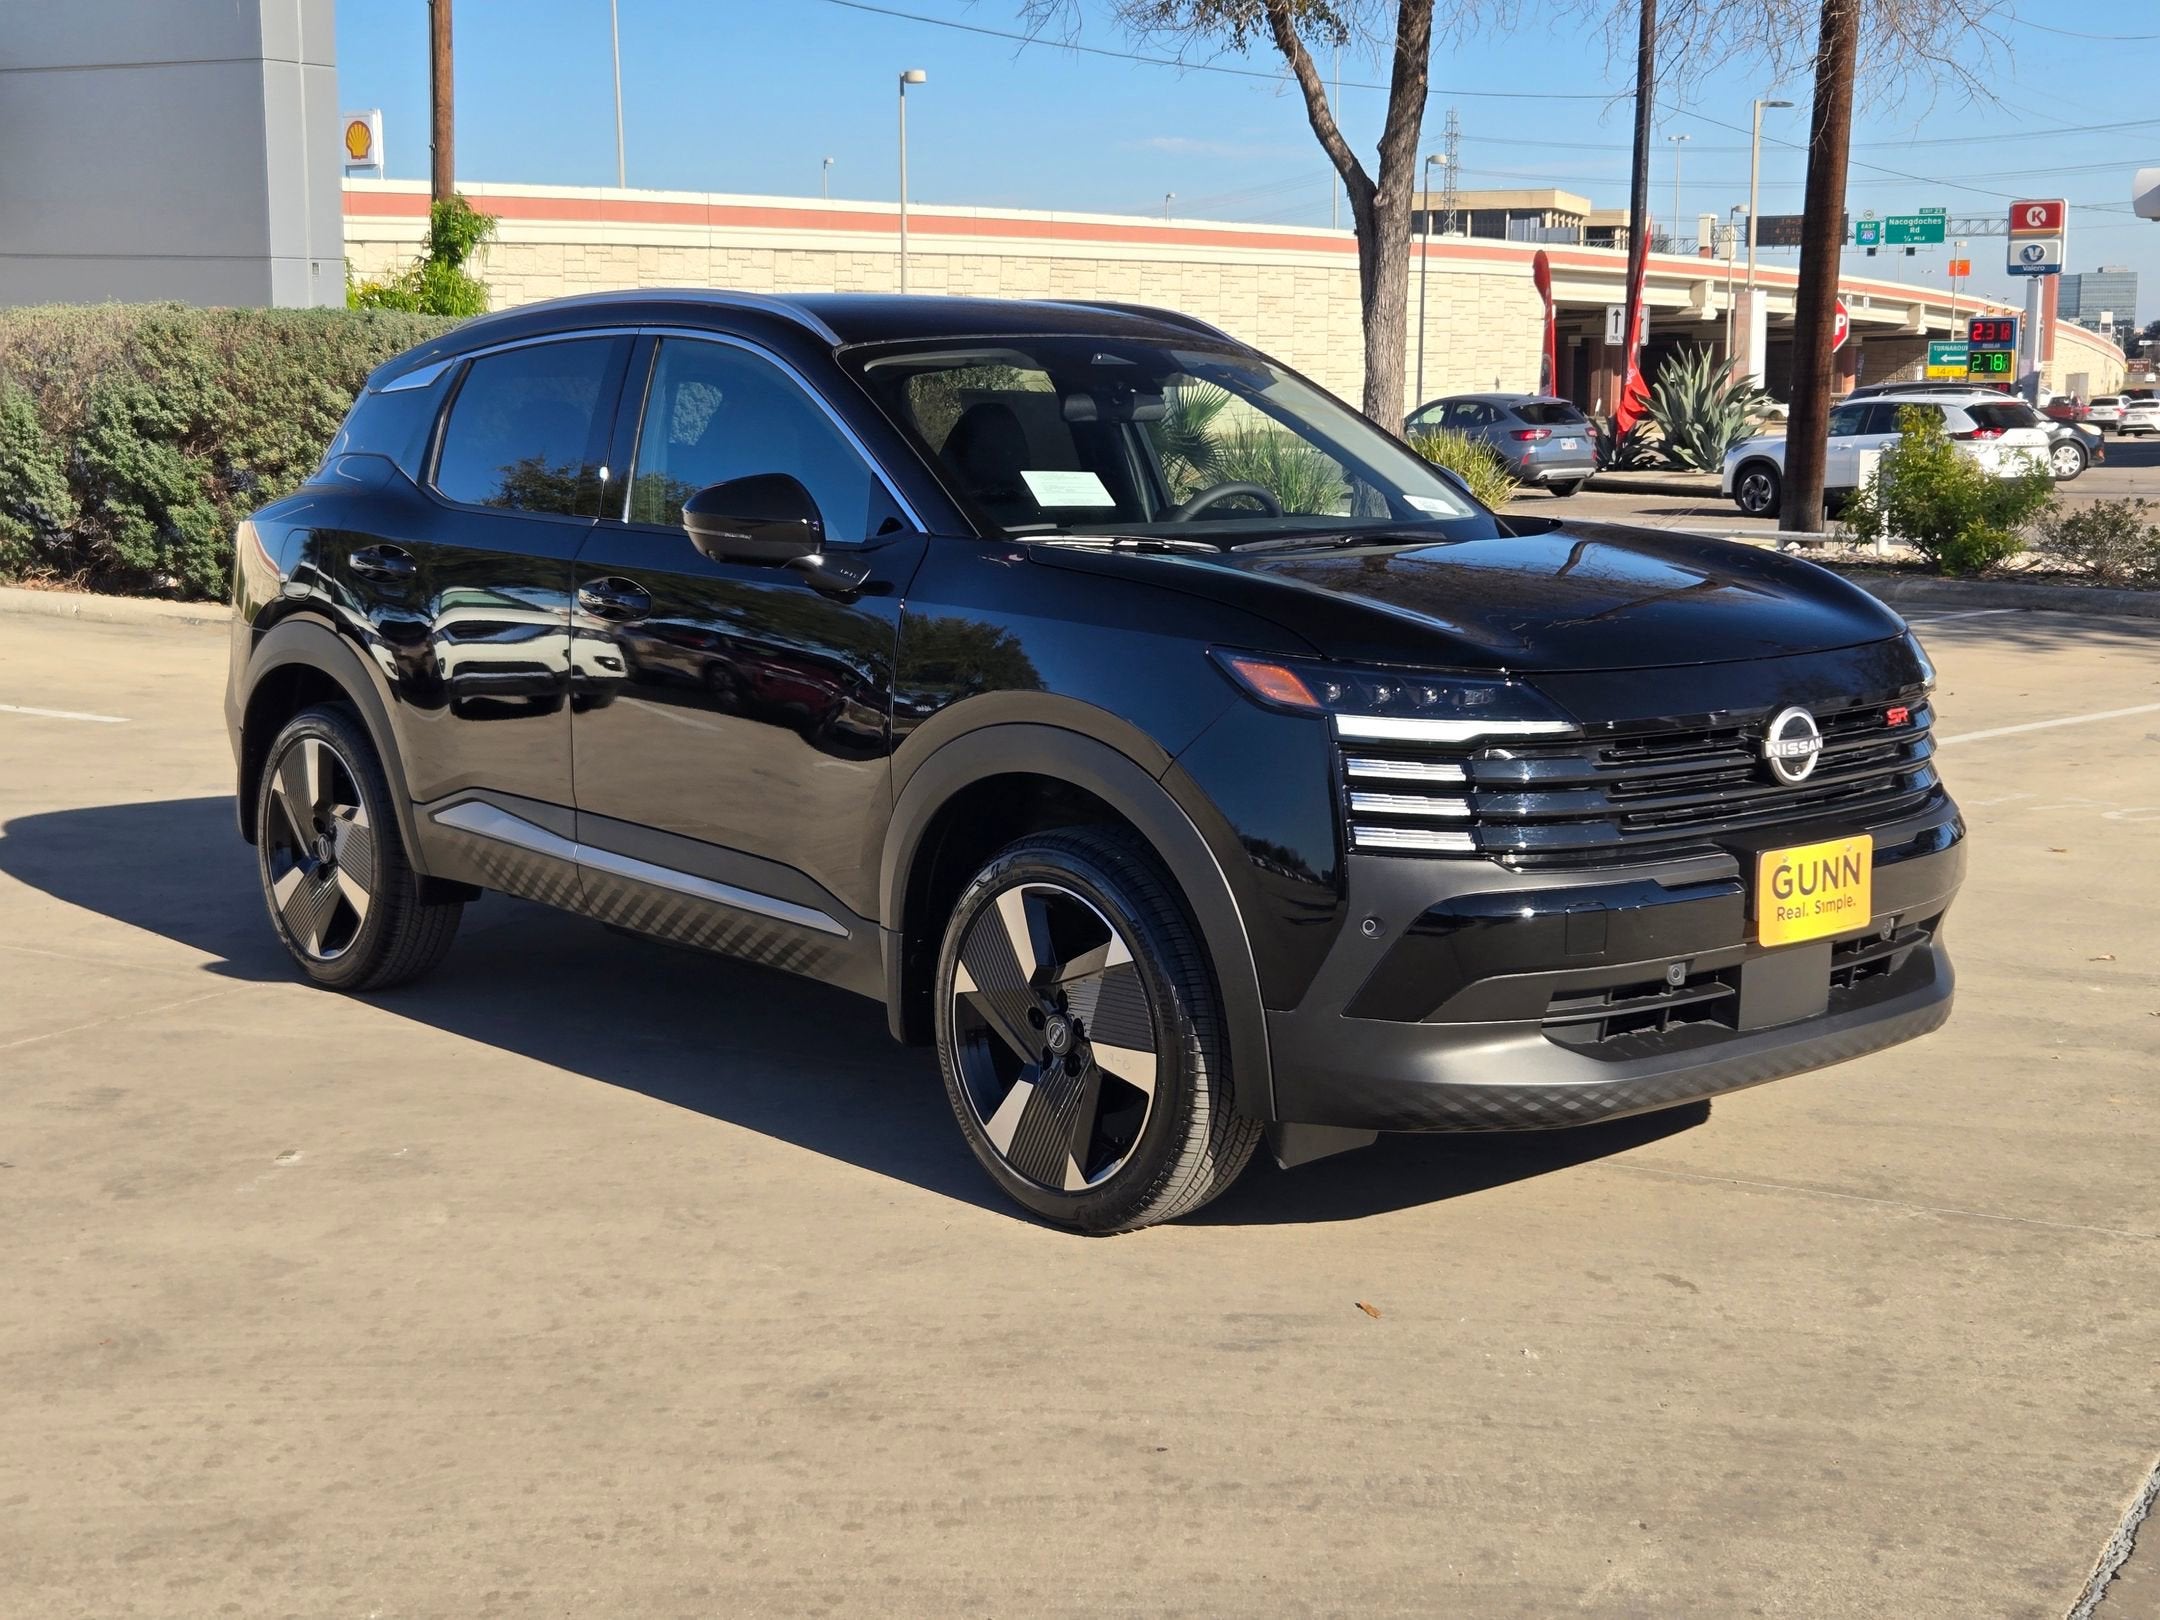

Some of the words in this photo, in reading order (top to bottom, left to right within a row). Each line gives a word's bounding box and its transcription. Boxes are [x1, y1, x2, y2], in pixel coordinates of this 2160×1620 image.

[1888, 218, 1942, 226] Nacogdoches
[2031, 210, 2044, 225] K
[1862, 232, 1875, 240] 410
[1909, 226, 1920, 234] Rd
[1887, 707, 1908, 725] SR
[1765, 736, 1823, 757] NISSAN
[1772, 852, 1861, 900] GUNN
[1776, 902, 1809, 921] Real.
[1814, 894, 1857, 915] Simple.
